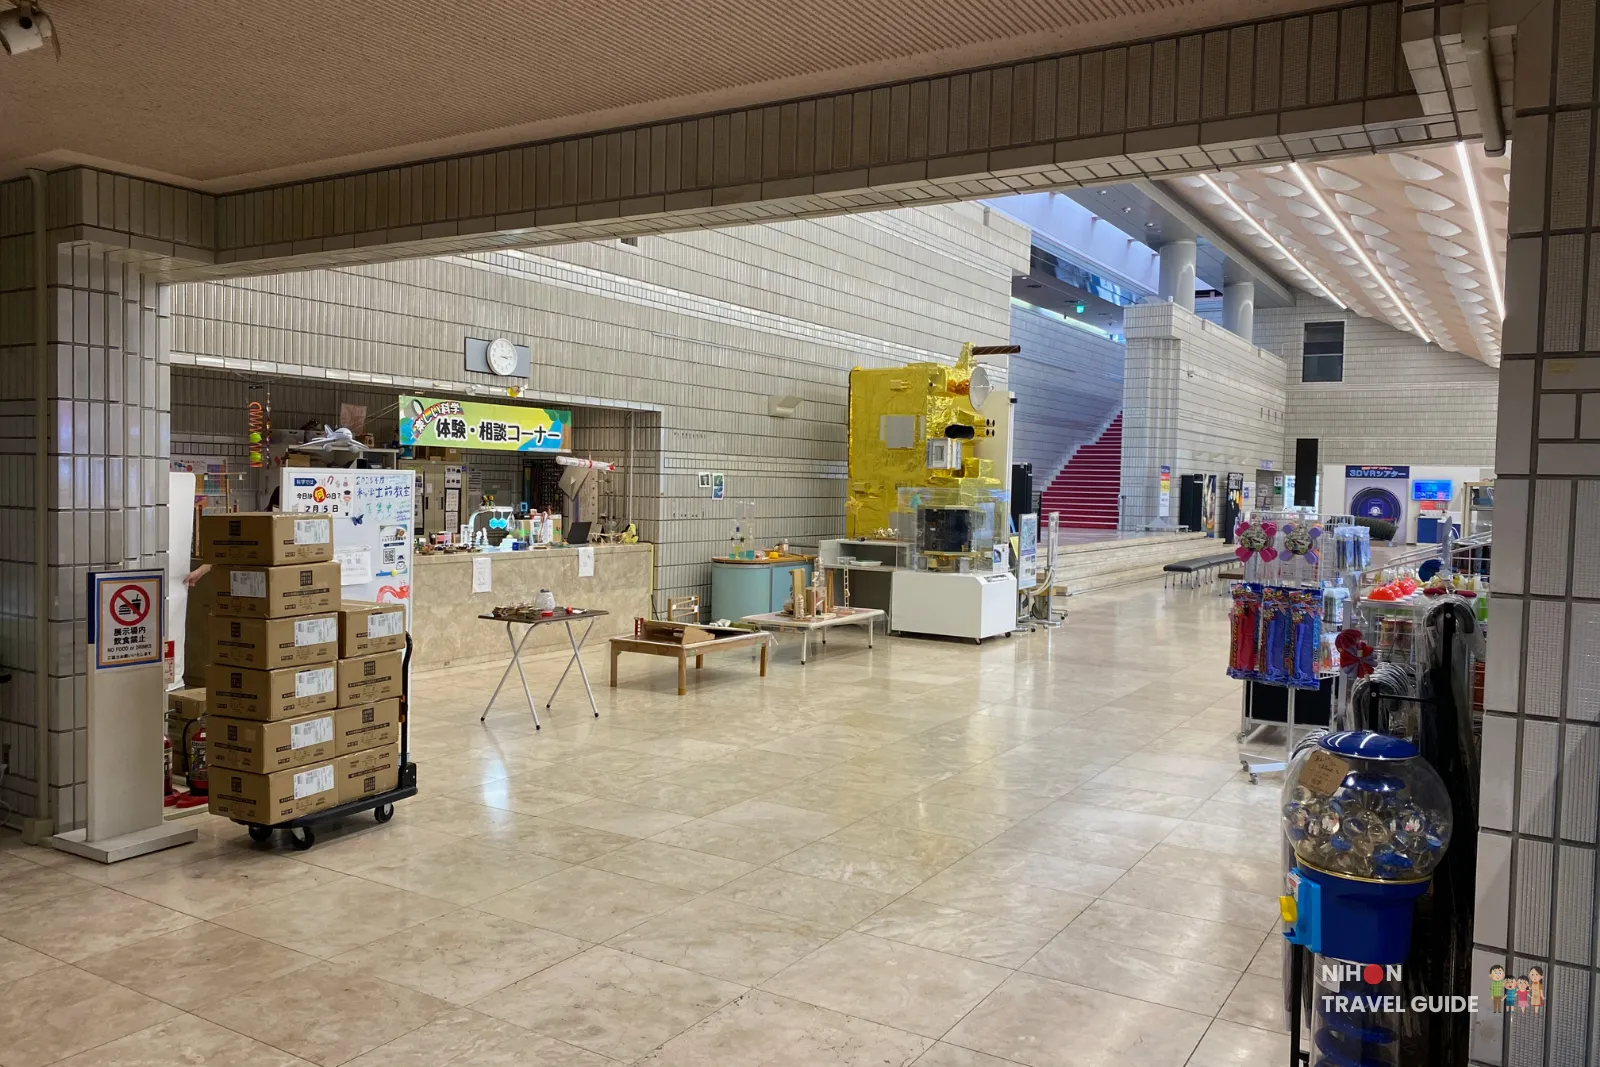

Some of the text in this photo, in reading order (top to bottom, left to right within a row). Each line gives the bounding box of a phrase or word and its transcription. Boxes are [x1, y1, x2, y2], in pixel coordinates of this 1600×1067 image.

[414, 402, 461, 434] 楽しい科学
[436, 418, 560, 443] 体験・相談コーナー
[1350, 469, 1407, 477] 3DVRシアター
[114, 626, 146, 637] 展示場内
[114, 635, 146, 645] 飲食禁止
